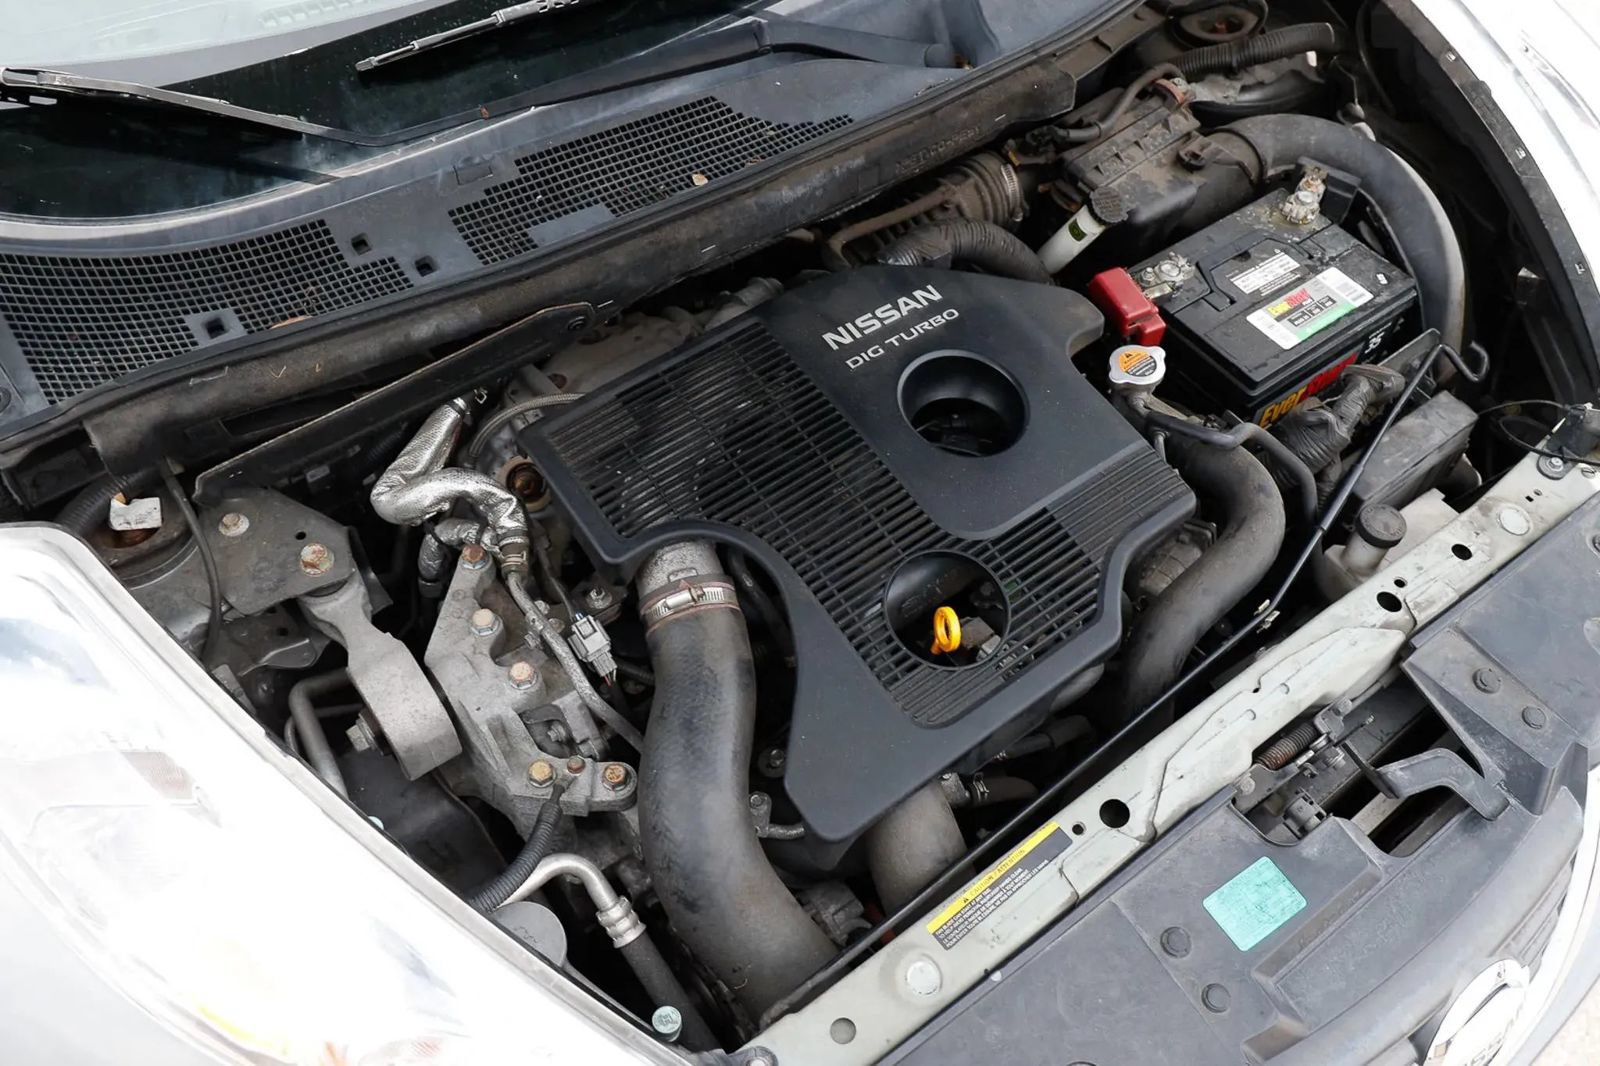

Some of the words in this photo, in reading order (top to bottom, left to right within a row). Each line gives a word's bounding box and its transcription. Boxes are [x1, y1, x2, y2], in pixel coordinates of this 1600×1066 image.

[822, 284, 943, 351] NISSAN
[845, 344, 885, 369] DIG
[884, 308, 960, 346] TURBO
[970, 875, 995, 896] CAUTION
[997, 848, 1025, 873] ATTENTION
